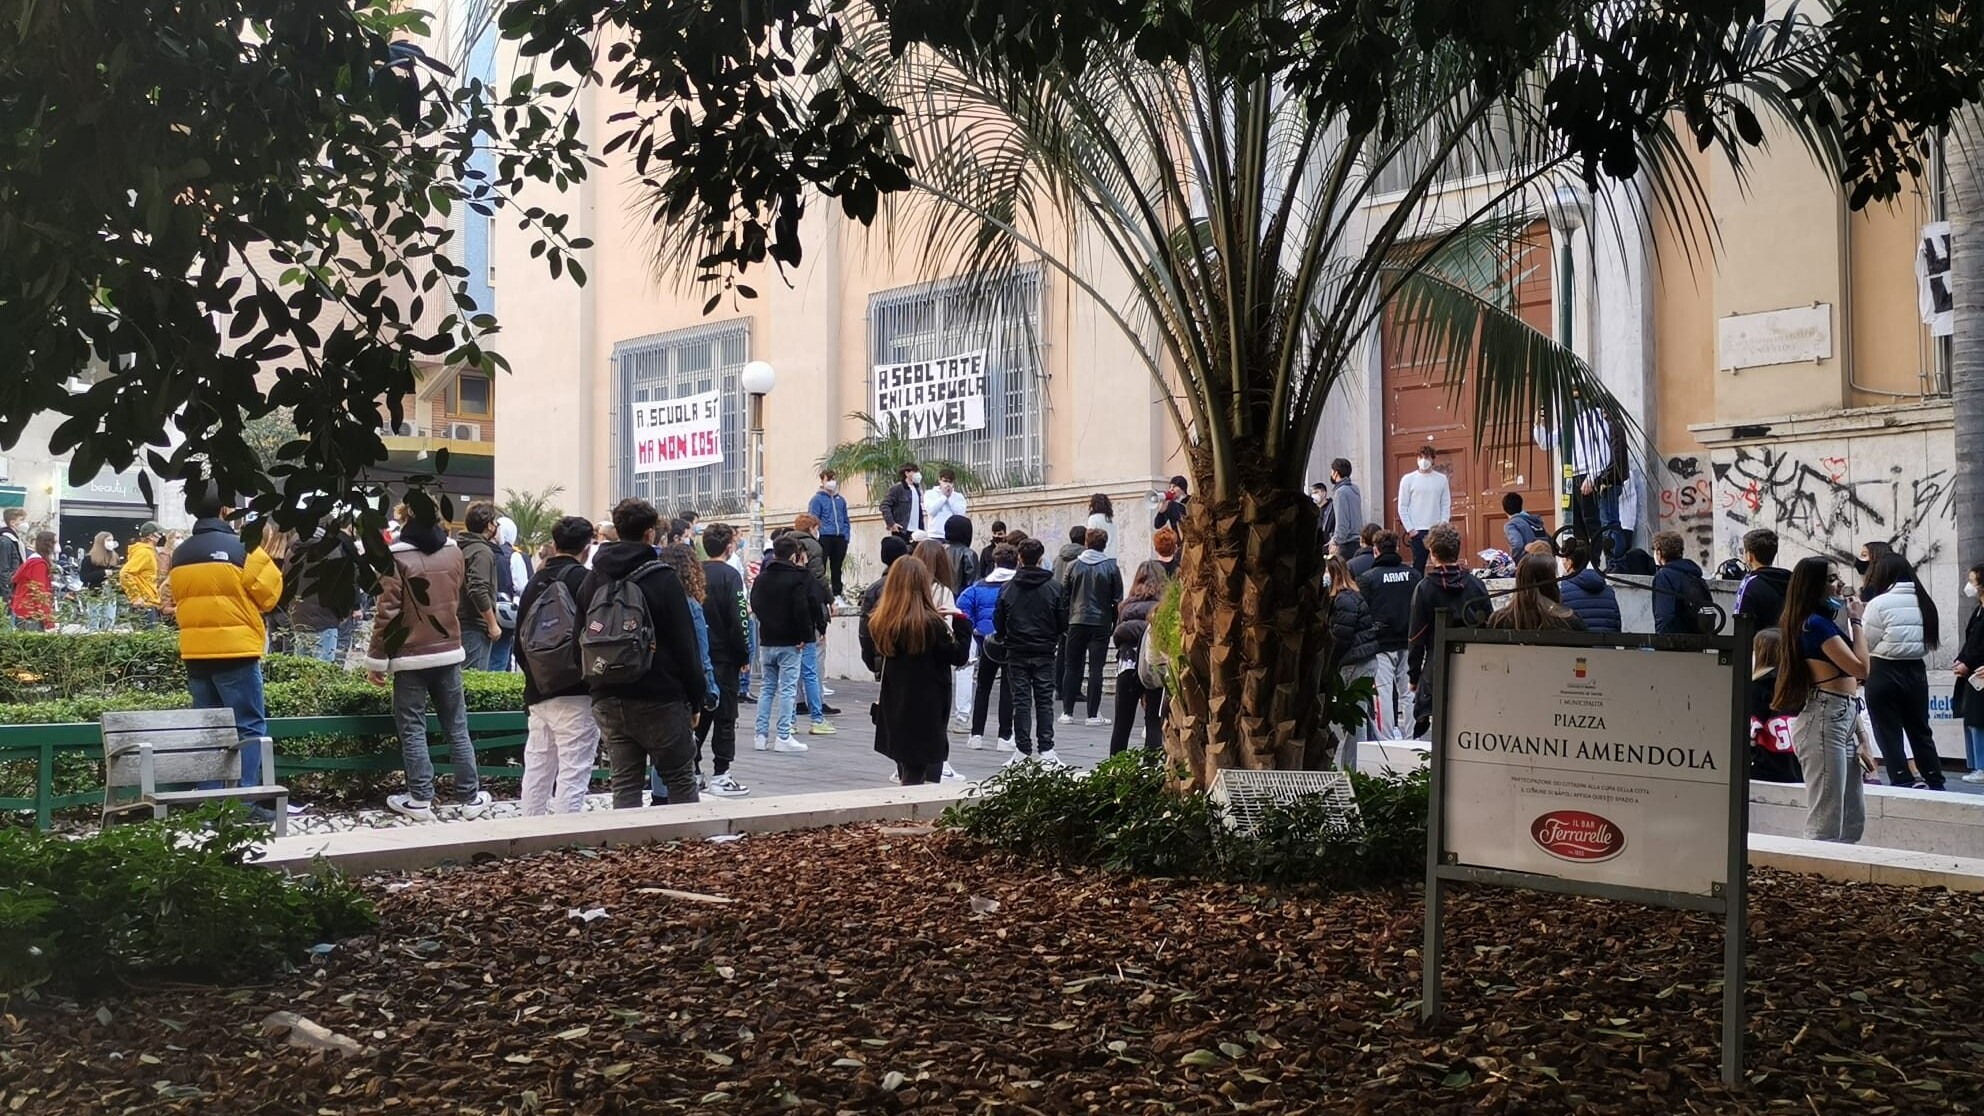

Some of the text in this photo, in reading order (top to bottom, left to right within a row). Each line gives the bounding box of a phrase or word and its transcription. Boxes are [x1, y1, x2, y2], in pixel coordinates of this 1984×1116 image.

[880, 376, 986, 411] CHI LA SCUOLA
[636, 409, 644, 428] A
[650, 403, 698, 427] SCUOLA
[638, 439, 654, 464] MA
[658, 433, 687, 462] NON
[91, 480, 127, 497] beauty
[1383, 571, 1410, 583] ARMY
[1554, 713, 1607, 730] PIAZZA
[1457, 731, 1717, 770] GIOVANNI AMENDOLA
[1539, 818, 1613, 845] Ferrarelle
[1572, 819, 1595, 829] IL BAR
